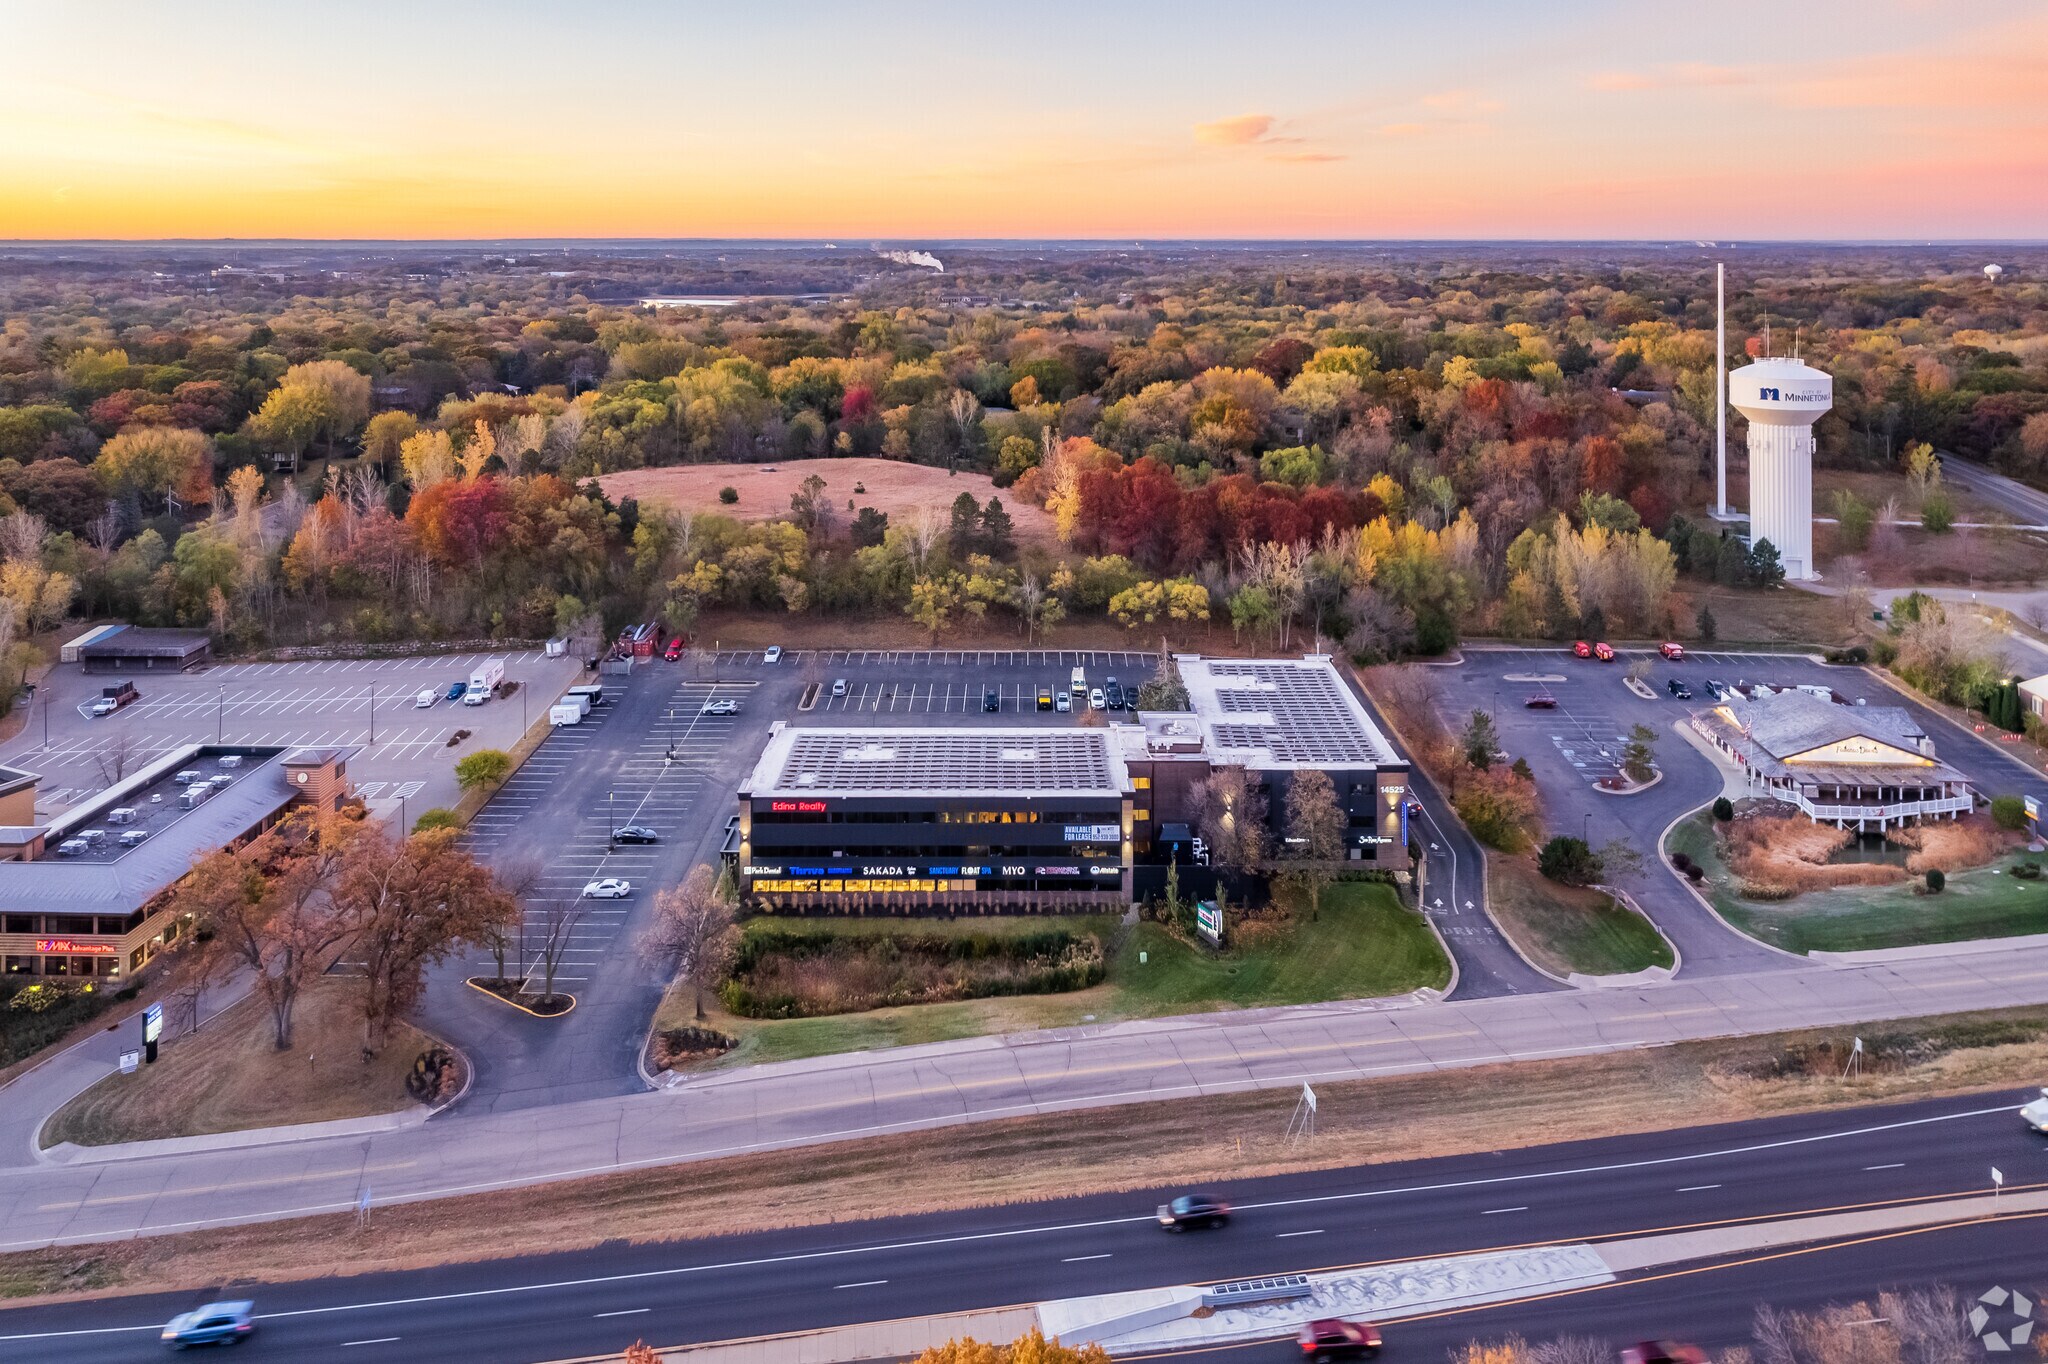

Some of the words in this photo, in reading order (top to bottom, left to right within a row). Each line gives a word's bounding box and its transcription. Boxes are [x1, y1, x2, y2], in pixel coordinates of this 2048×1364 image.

[1380, 785, 1405, 794] 14525
[772, 802, 796, 811] Edina
[798, 802, 827, 812] Realty
[1064, 833, 1075, 841] FOR
[1075, 833, 1092, 841] LEASE
[751, 866, 764, 875] Park
[863, 867, 903, 875] SAKADA
[929, 867, 959, 875] SANCTUARY
[981, 867, 992, 875] SPA
[1002, 866, 1025, 875] MYO
